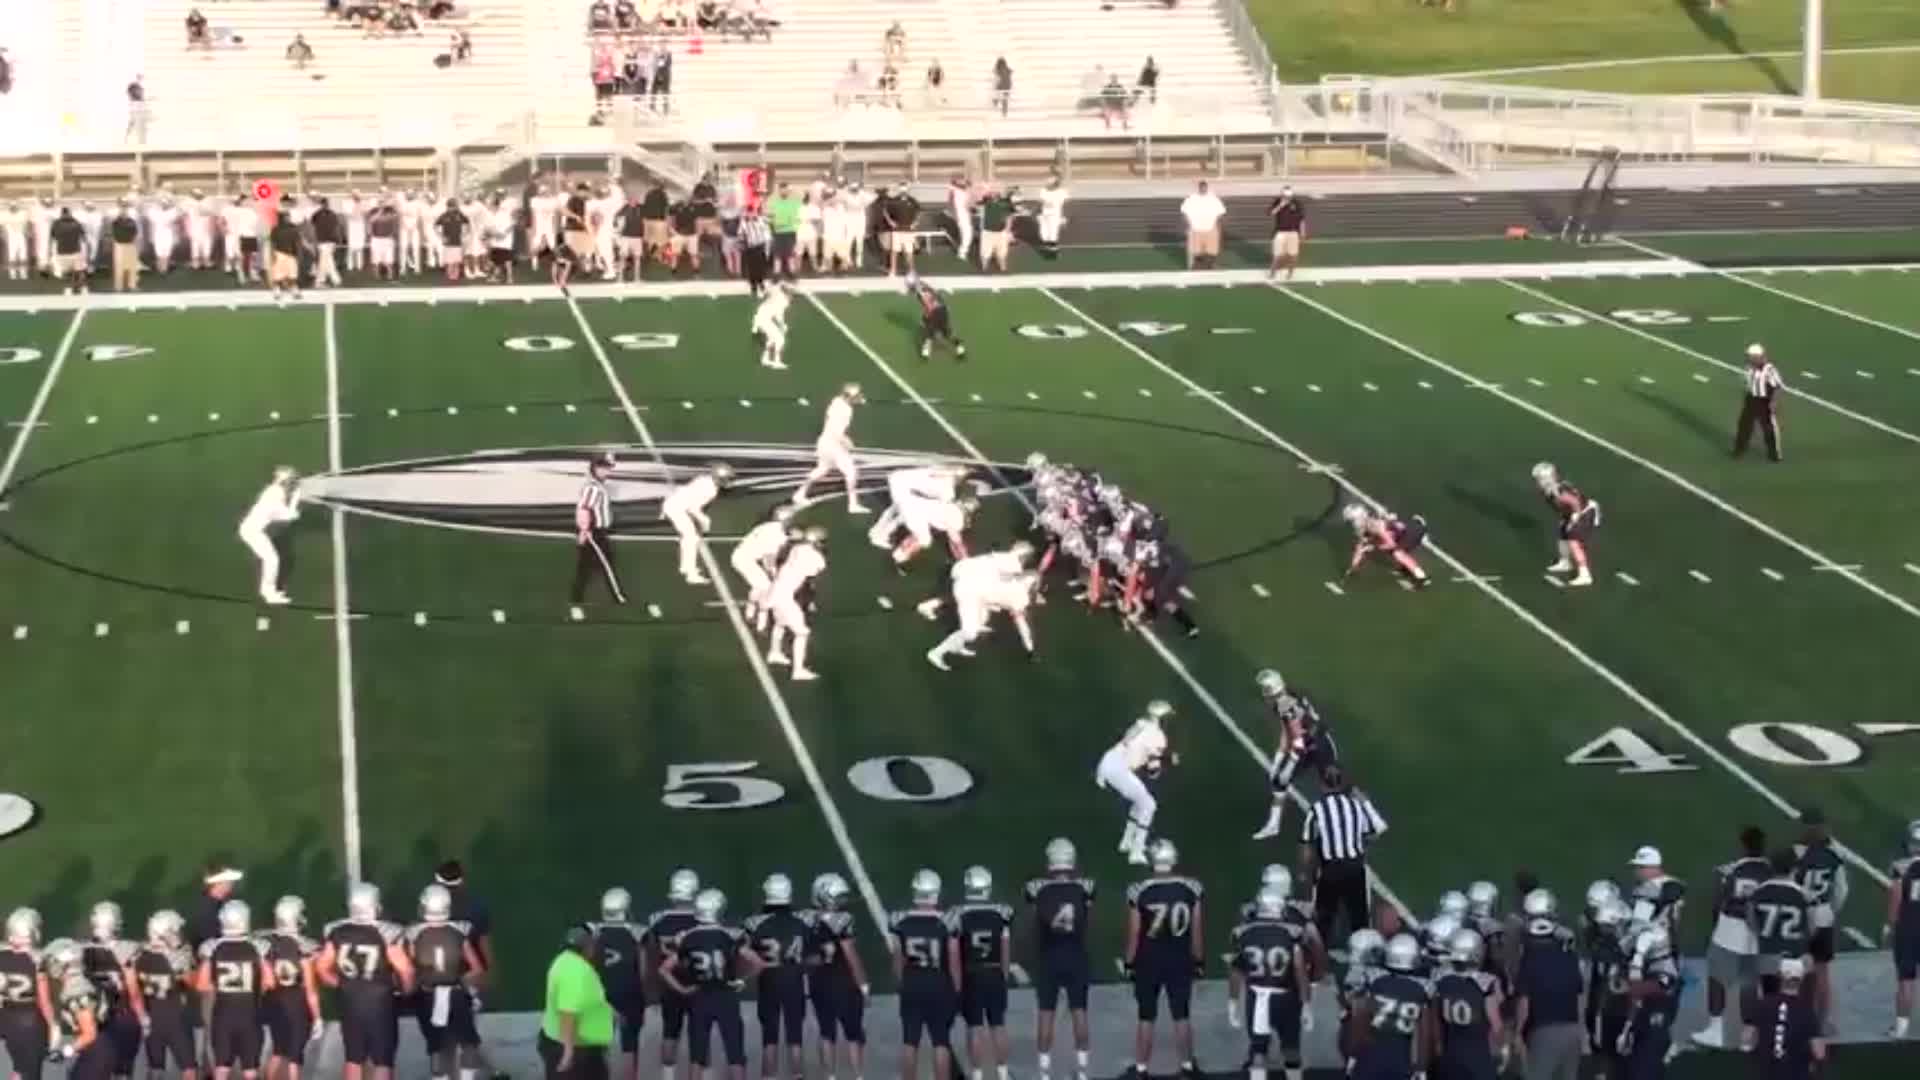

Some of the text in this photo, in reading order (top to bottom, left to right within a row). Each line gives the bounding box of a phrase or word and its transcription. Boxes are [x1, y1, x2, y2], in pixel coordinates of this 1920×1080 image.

[1563, 721, 1862, 774] 40
[661, 754, 976, 808] 50
[1051, 902, 1076, 932] 4
[1145, 901, 1191, 938] 70
[1756, 903, 1802, 940] 72
[337, 943, 379, 981] 67
[434, 945, 446, 973] 1
[764, 935, 804, 968] 34
[905, 936, 941, 968] 51
[1243, 945, 1291, 977] 30
[215, 959, 254, 994] 21
[1442, 997, 1473, 1026] 10
